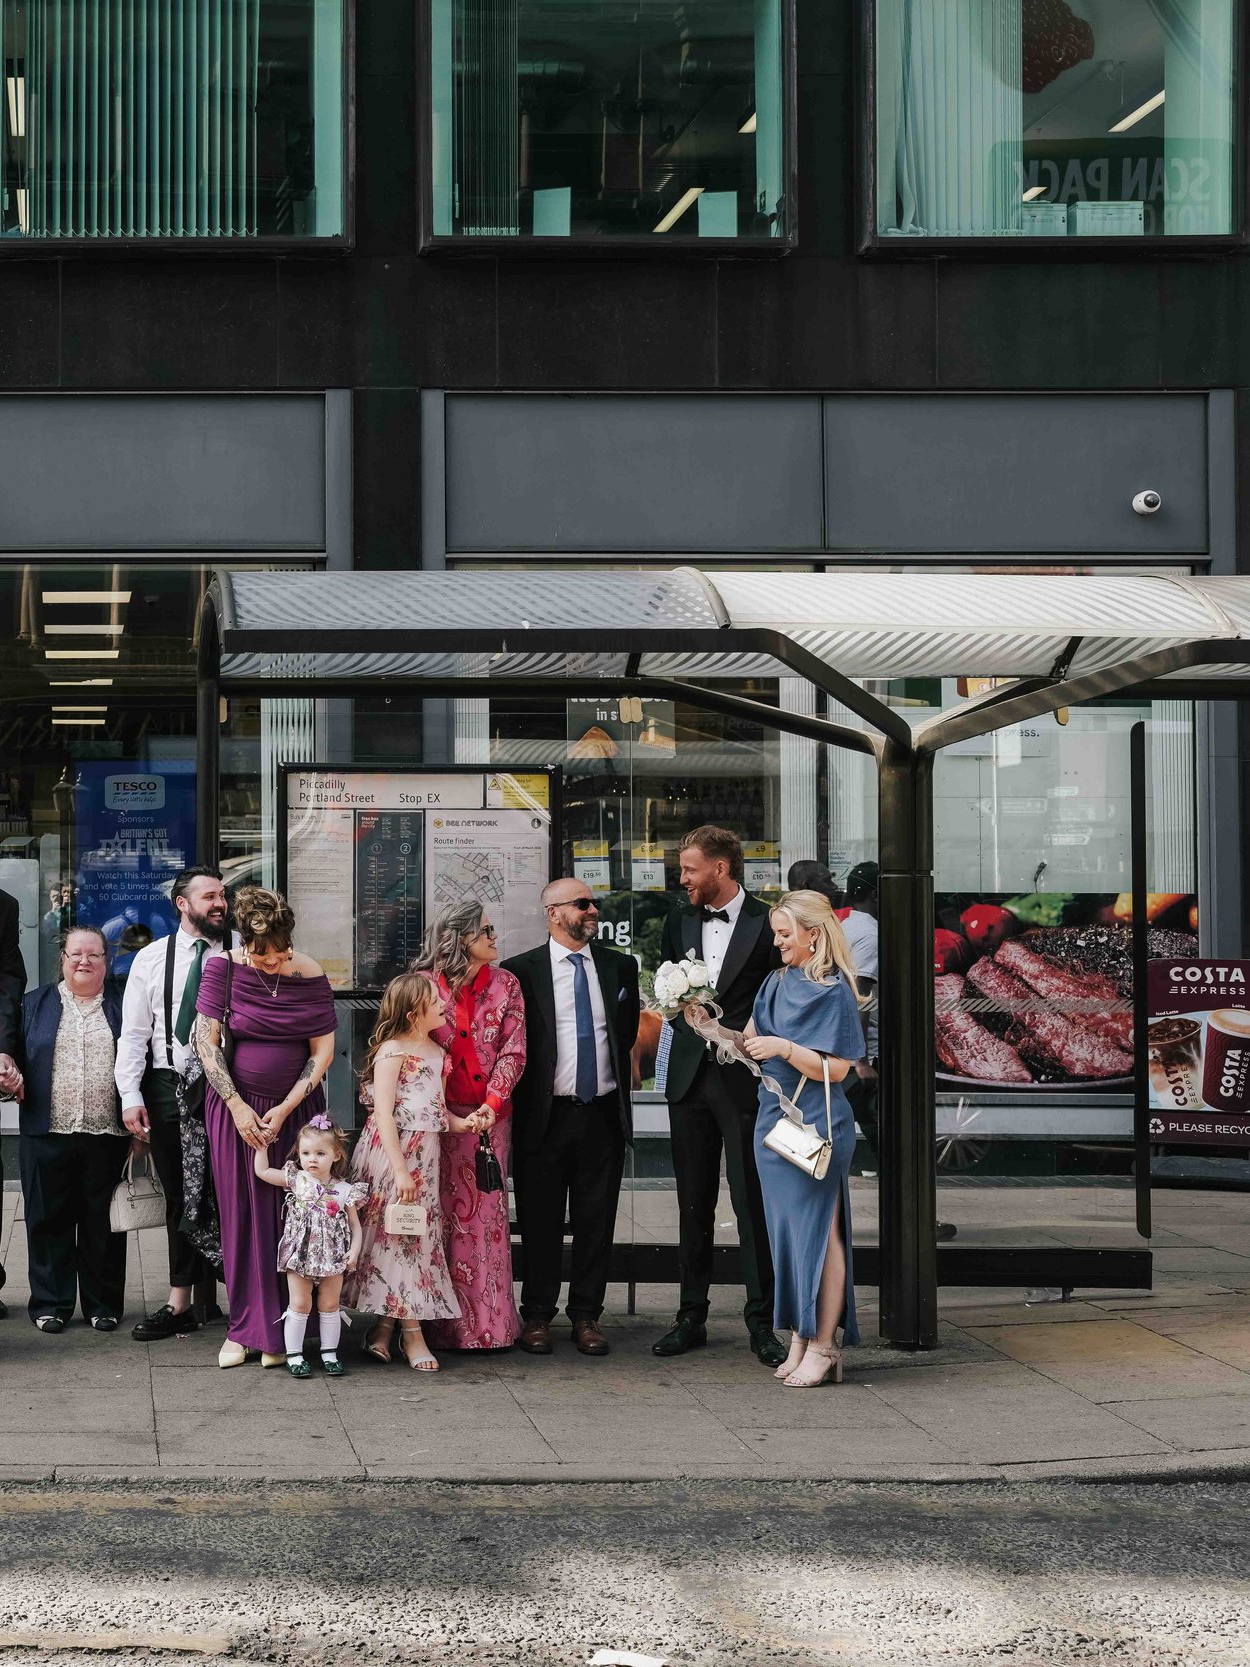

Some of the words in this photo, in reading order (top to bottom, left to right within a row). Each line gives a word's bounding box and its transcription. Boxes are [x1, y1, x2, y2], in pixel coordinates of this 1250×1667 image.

[596, 708, 608, 721] in
[113, 782, 157, 791] TESCO
[299, 779, 345, 791] Piccadilly
[344, 793, 375, 803] Street
[399, 793, 422, 805] Stop
[427, 793, 440, 803] EX
[117, 815, 154, 823] Sponsors
[120, 828, 153, 838] BRITAIN'S
[141, 872, 176, 881] Saturday
[84, 882, 98, 890] and
[128, 882, 149, 890] times
[99, 893, 110, 901] 50
[111, 893, 147, 901] Clubcard
[149, 893, 167, 902] poin
[1169, 966, 1246, 984] COSTA
[1181, 986, 1246, 995] EXPRESS
[1219, 1049, 1243, 1097] COSTA
[1169, 1122, 1213, 1133] PLEASE
